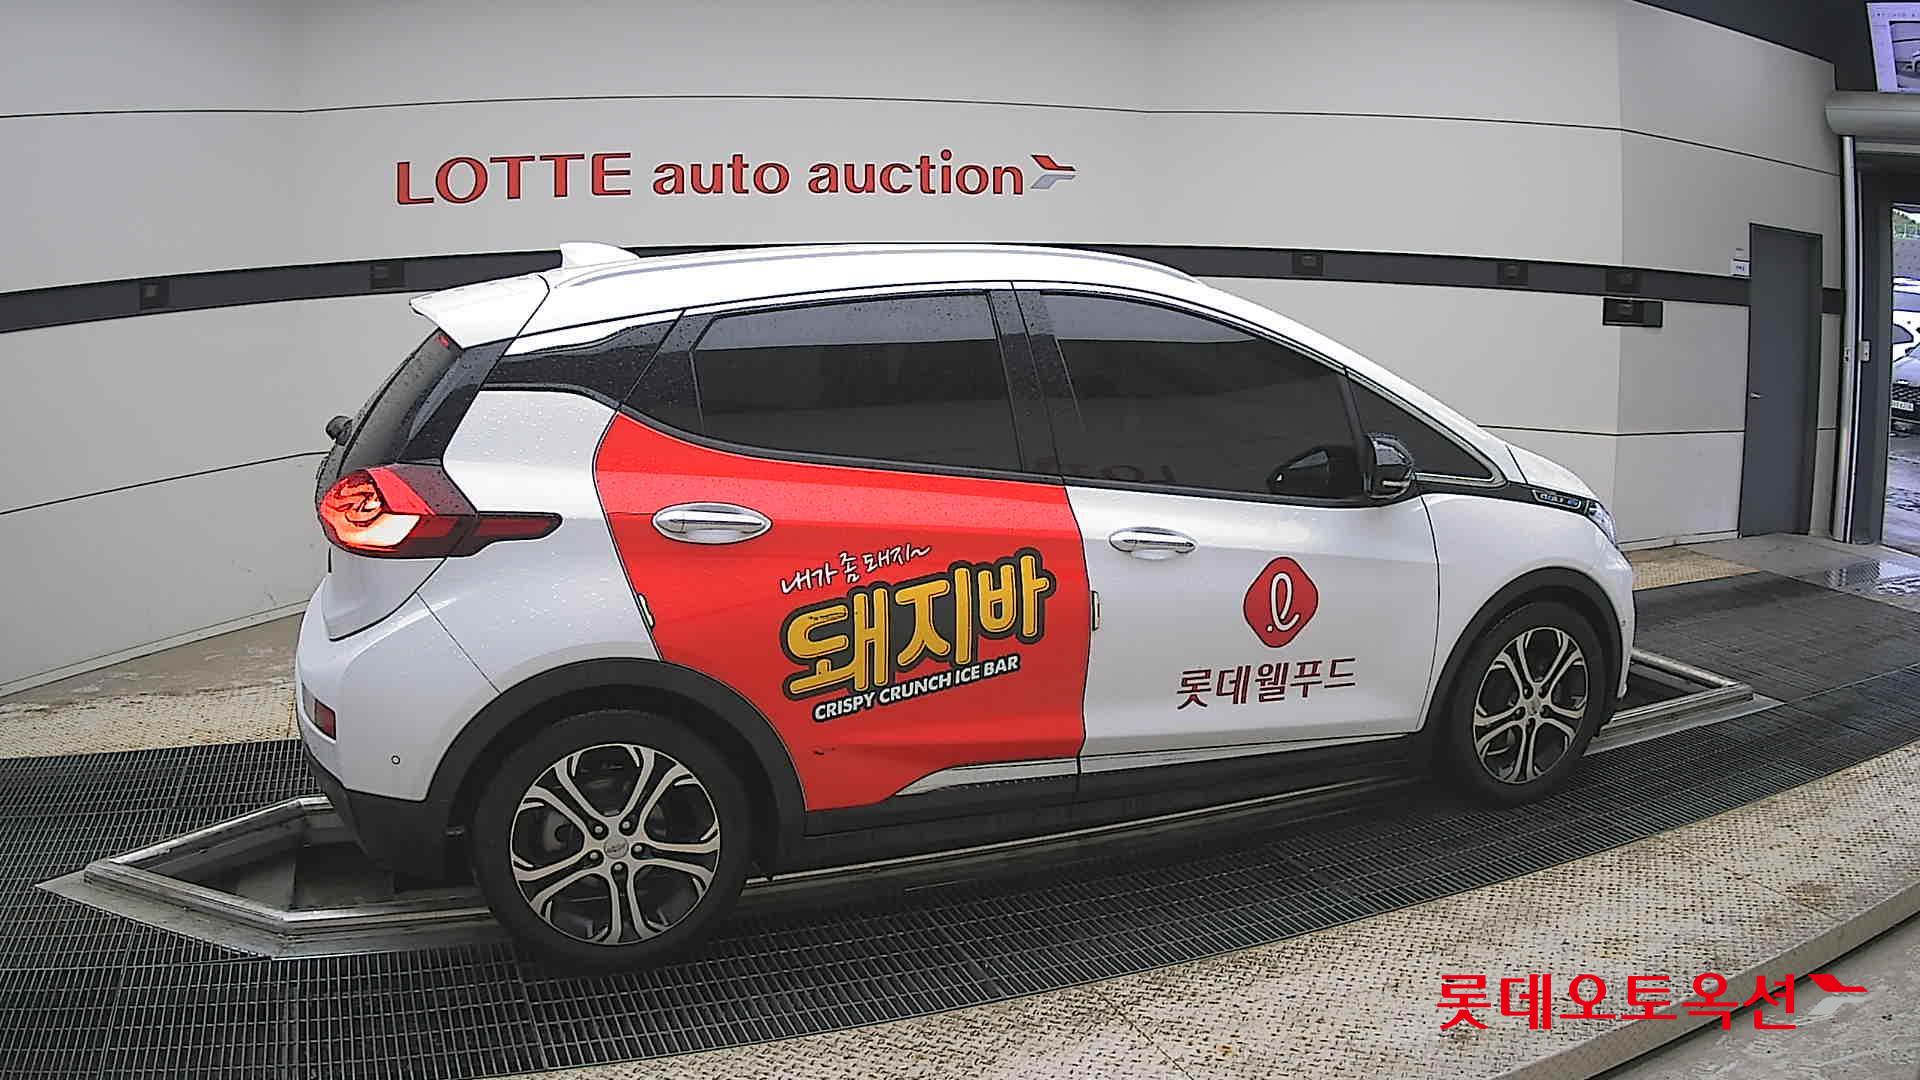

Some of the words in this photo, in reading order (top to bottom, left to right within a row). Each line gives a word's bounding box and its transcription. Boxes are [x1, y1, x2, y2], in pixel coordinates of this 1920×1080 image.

[396, 152, 632, 205] LOTTE
[652, 153, 790, 196] auto
[808, 149, 1023, 196] auction
[781, 562, 838, 594] 내가
[840, 551, 860, 583] 좀
[784, 552, 1052, 697] 돼지바
[814, 692, 877, 721] CRISPY
[879, 672, 951, 705] CRUNCH
[954, 664, 980, 684] ICE
[983, 655, 1019, 677] BAR
[1177, 658, 1356, 710] 롯데웰푸드
